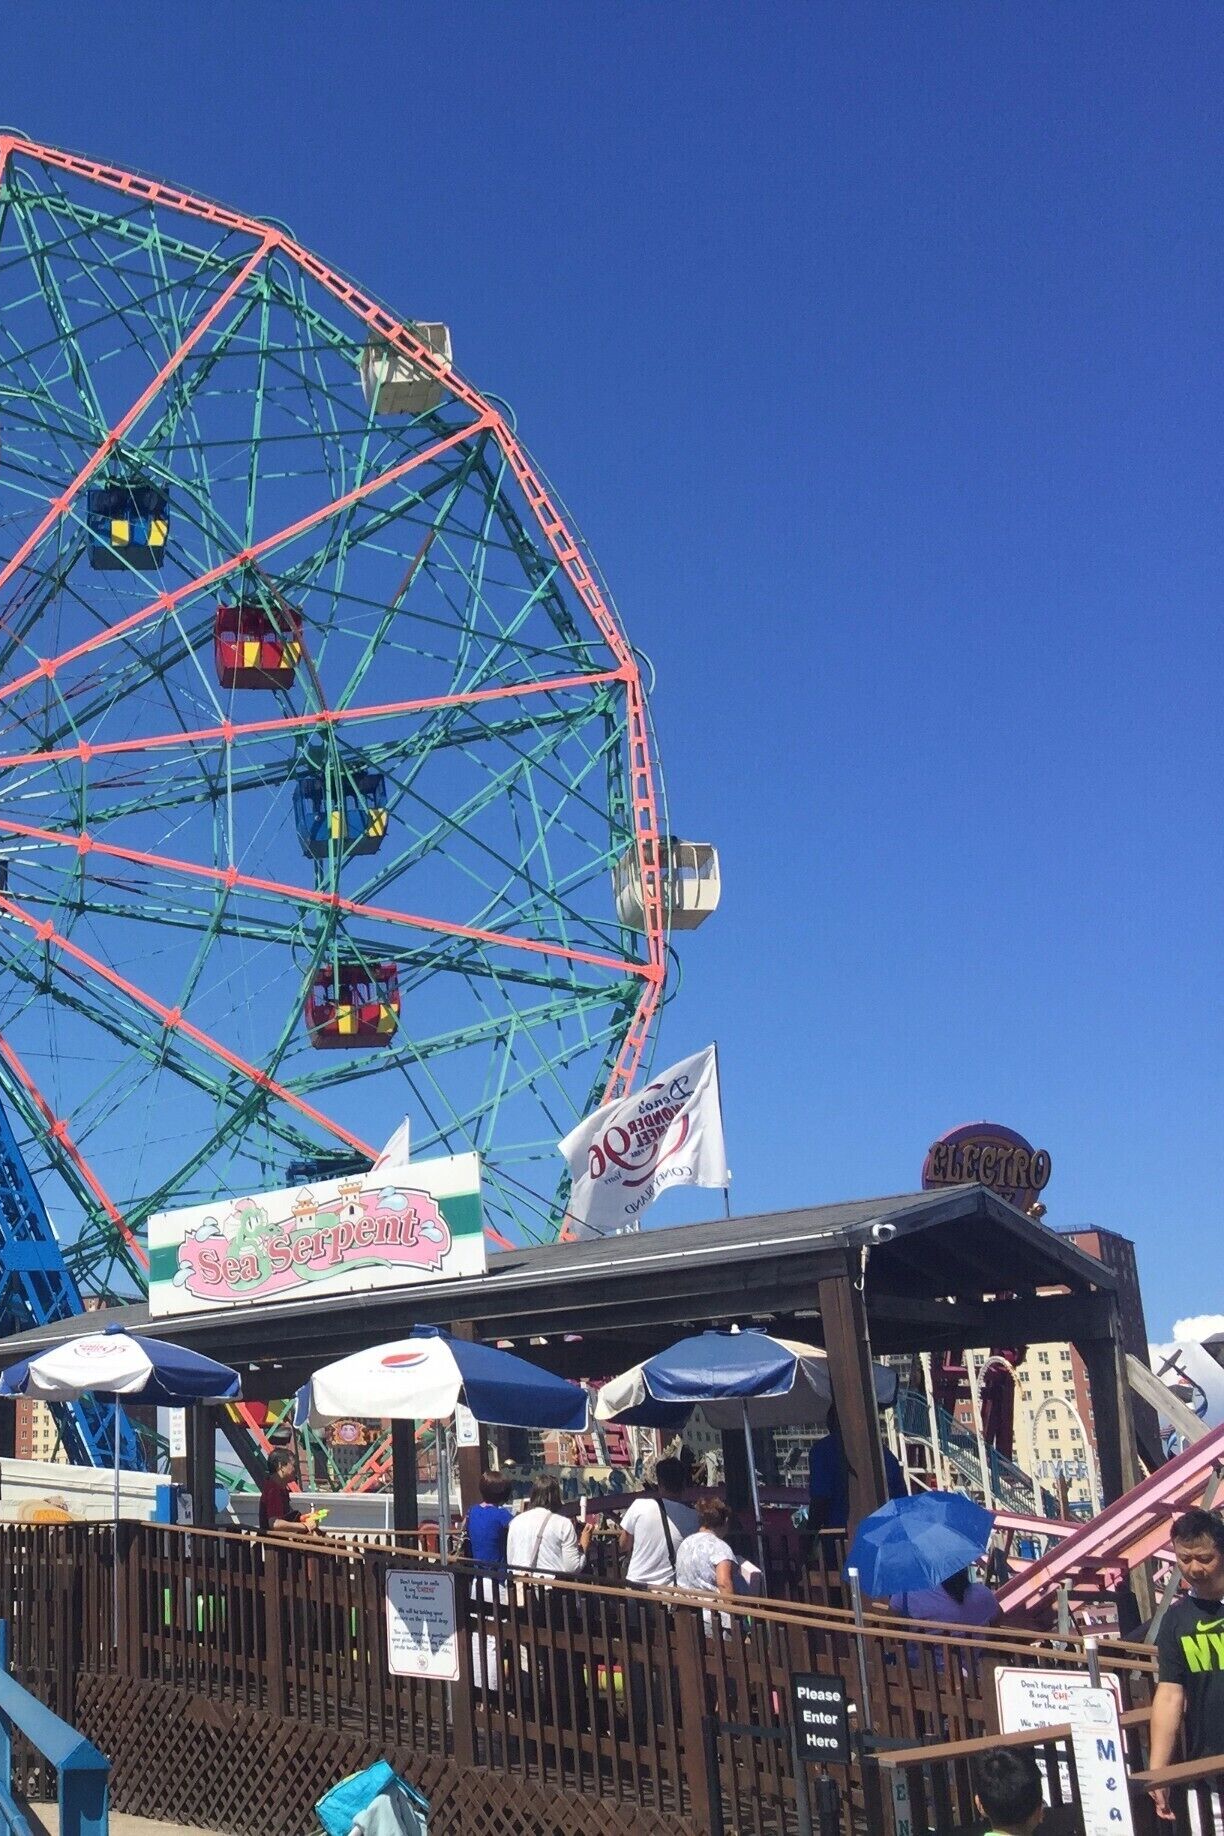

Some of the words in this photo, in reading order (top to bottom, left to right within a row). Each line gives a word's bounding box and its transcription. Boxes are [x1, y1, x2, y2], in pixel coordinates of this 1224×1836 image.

[928, 1142, 1051, 1190] ELECTRO
[198, 1249, 261, 1284] Sea
[267, 1208, 420, 1275] Serpent
[1020, 1680, 1039, 1688] Don't
[1040, 1682, 1062, 1691] forget
[797, 1686, 841, 1702] Please
[1031, 1701, 1042, 1709] for
[1044, 1702, 1056, 1710] the
[803, 1710, 838, 1725] Enter
[1020, 1719, 1032, 1727] We
[806, 1733, 838, 1748] Here
